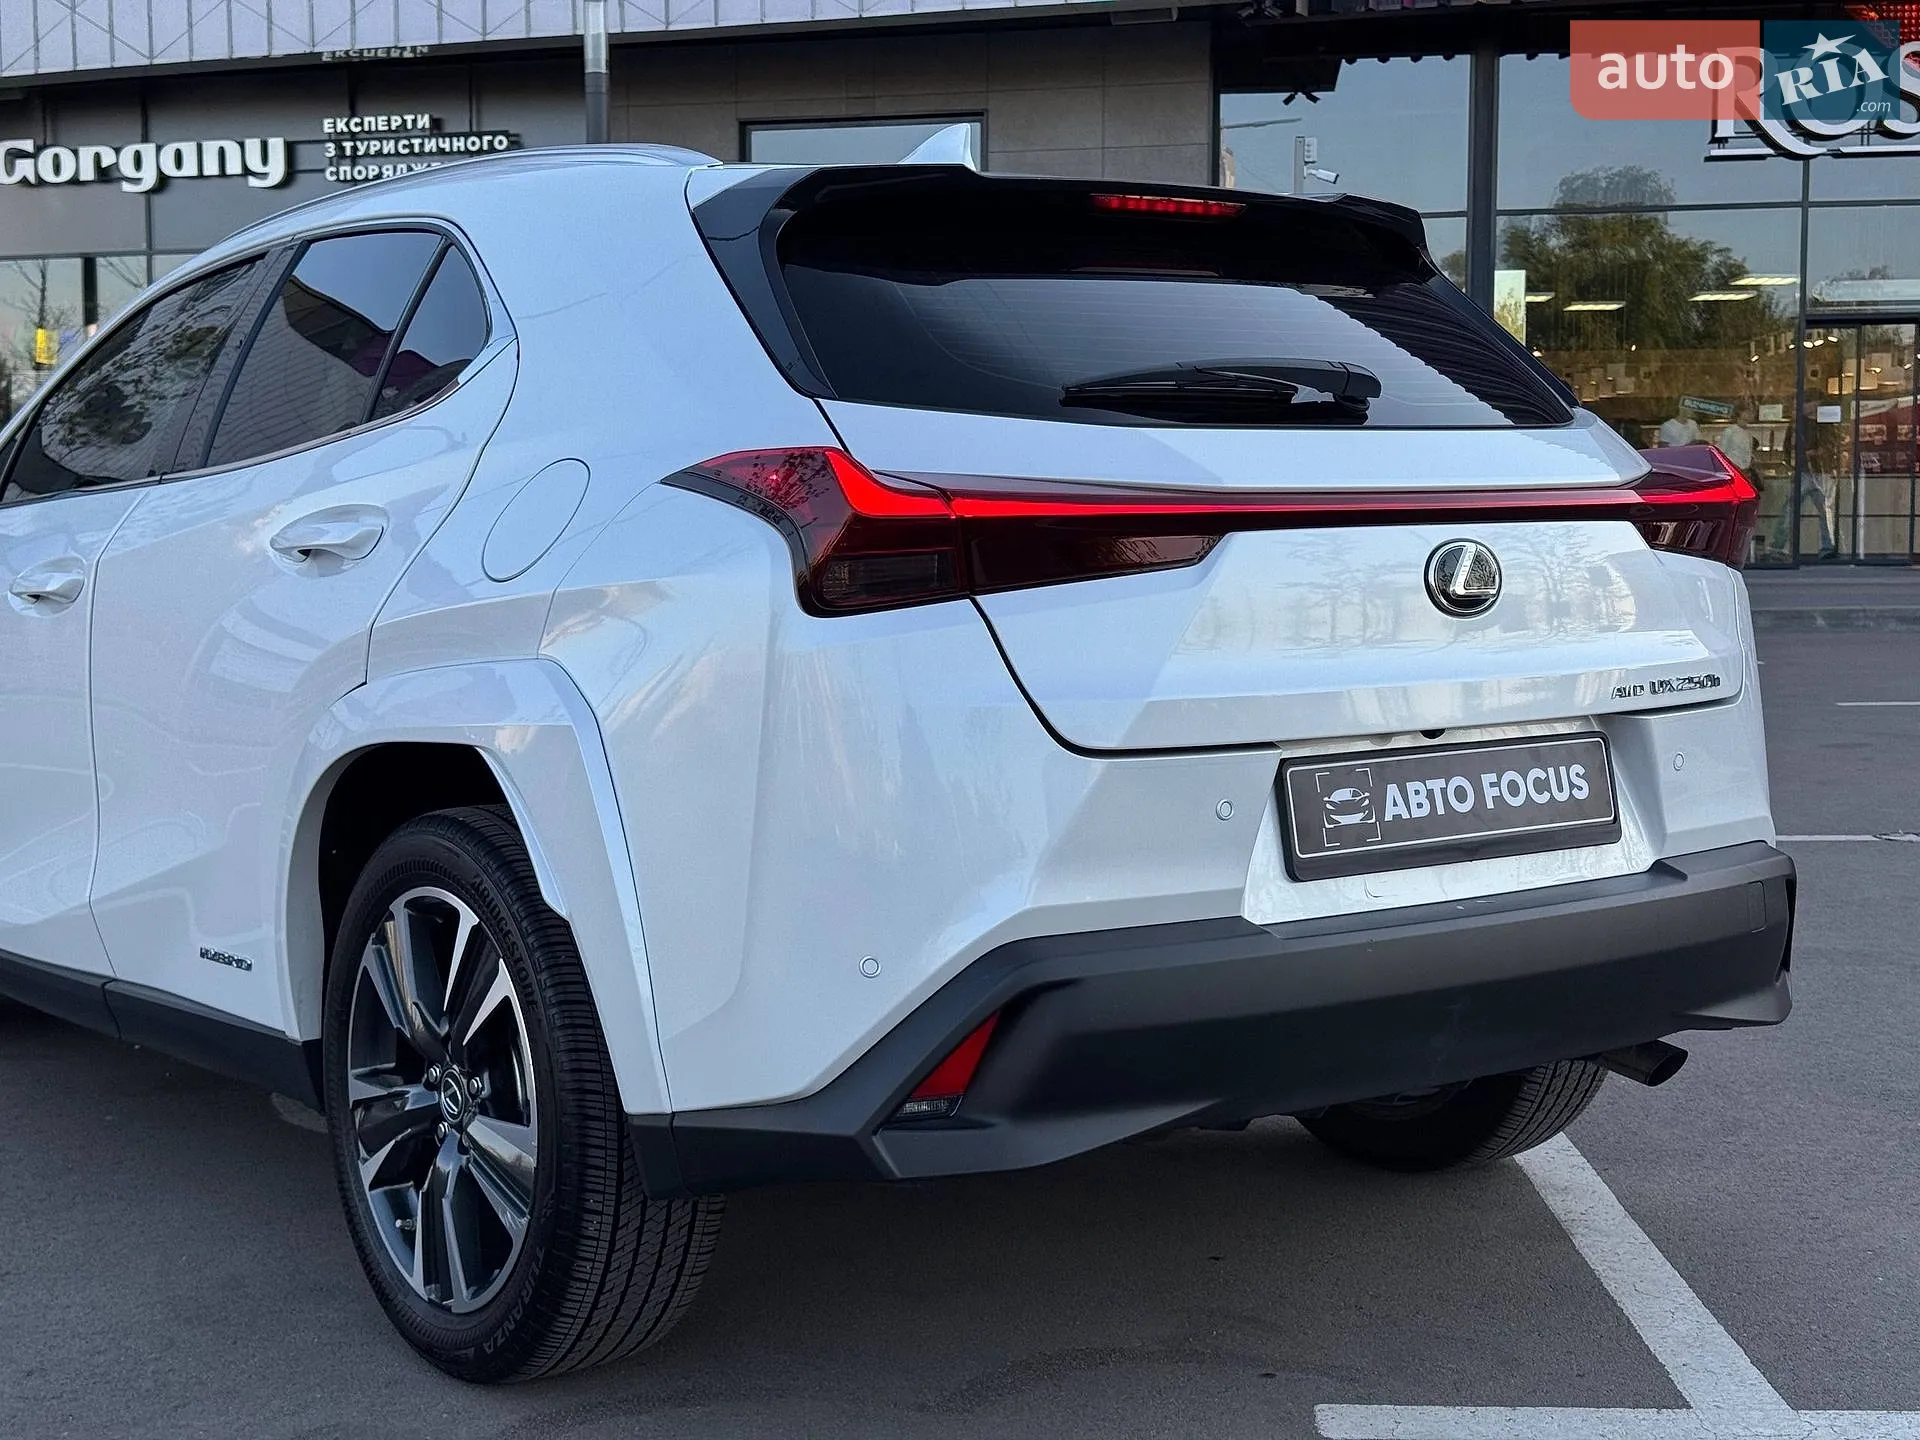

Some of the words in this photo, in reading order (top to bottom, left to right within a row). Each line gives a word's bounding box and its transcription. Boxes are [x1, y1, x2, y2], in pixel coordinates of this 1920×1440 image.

[322, 113, 431, 134] ЕКСПЕРТИ
[0, 136, 287, 193] Gorgany
[341, 135, 509, 158] ТУРИСТИЧНОГО
[1384, 774, 1476, 822] АВТО
[1481, 764, 1591, 810] FOCUS
